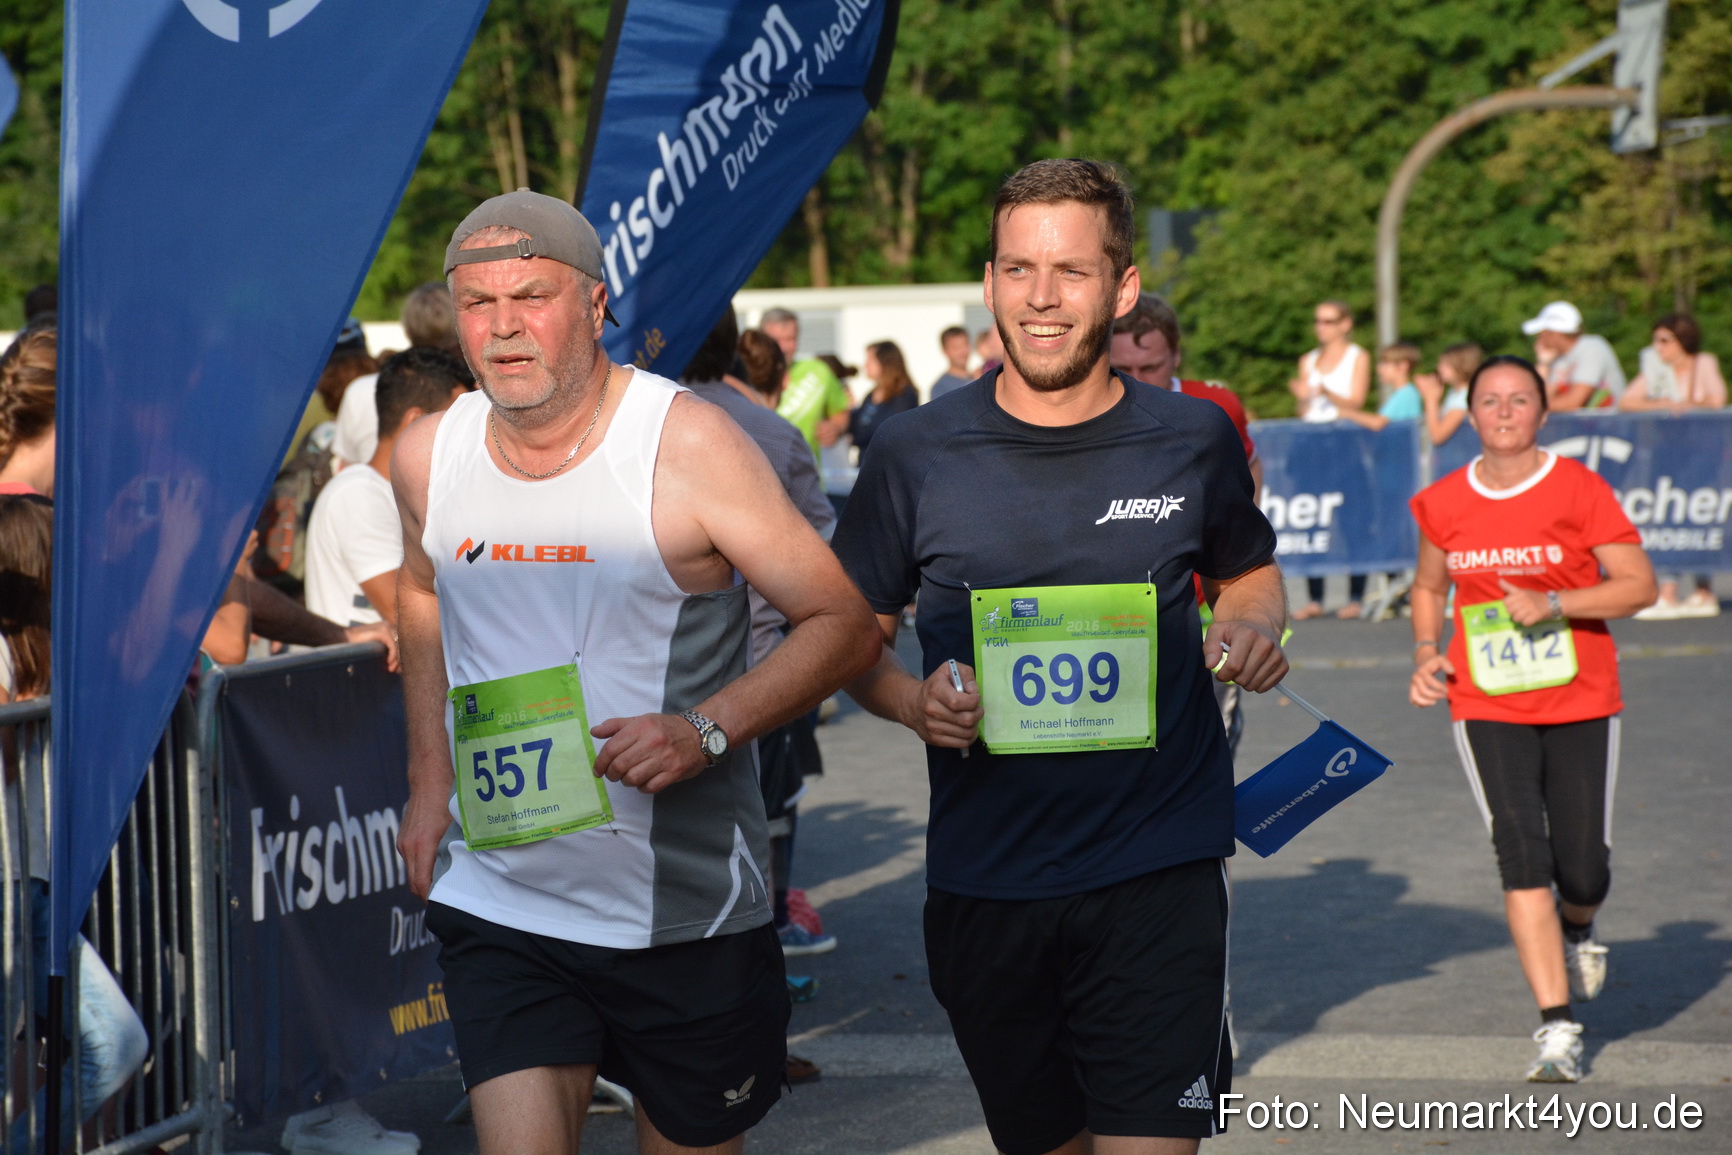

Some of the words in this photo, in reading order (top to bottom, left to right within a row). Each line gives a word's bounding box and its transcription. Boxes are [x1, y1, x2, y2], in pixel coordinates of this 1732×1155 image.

[601, 3, 803, 298] rischmann
[721, 104, 778, 191] Druck
[1095, 498, 1162, 525] JURA
[1613, 474, 1732, 526] cher
[491, 543, 596, 563] KLEBL
[1446, 545, 1543, 570] EUMARKT
[1000, 613, 1064, 628] firmenlauf
[1066, 619, 1100, 632] 2016
[1480, 630, 1563, 668] 1412
[1012, 651, 1120, 707] 699
[498, 710, 527, 726] 2016
[1020, 718, 1062, 730] Michael
[1064, 717, 1115, 727] Hoffmann
[1033, 732, 1066, 740] Lebenshilfe
[472, 737, 554, 803] 557
[486, 813, 511, 825] Stefan
[511, 804, 560, 820] Hoffmann
[1251, 778, 1328, 834] Lebenshilfe
[1177, 1095, 1214, 1110] adidas
